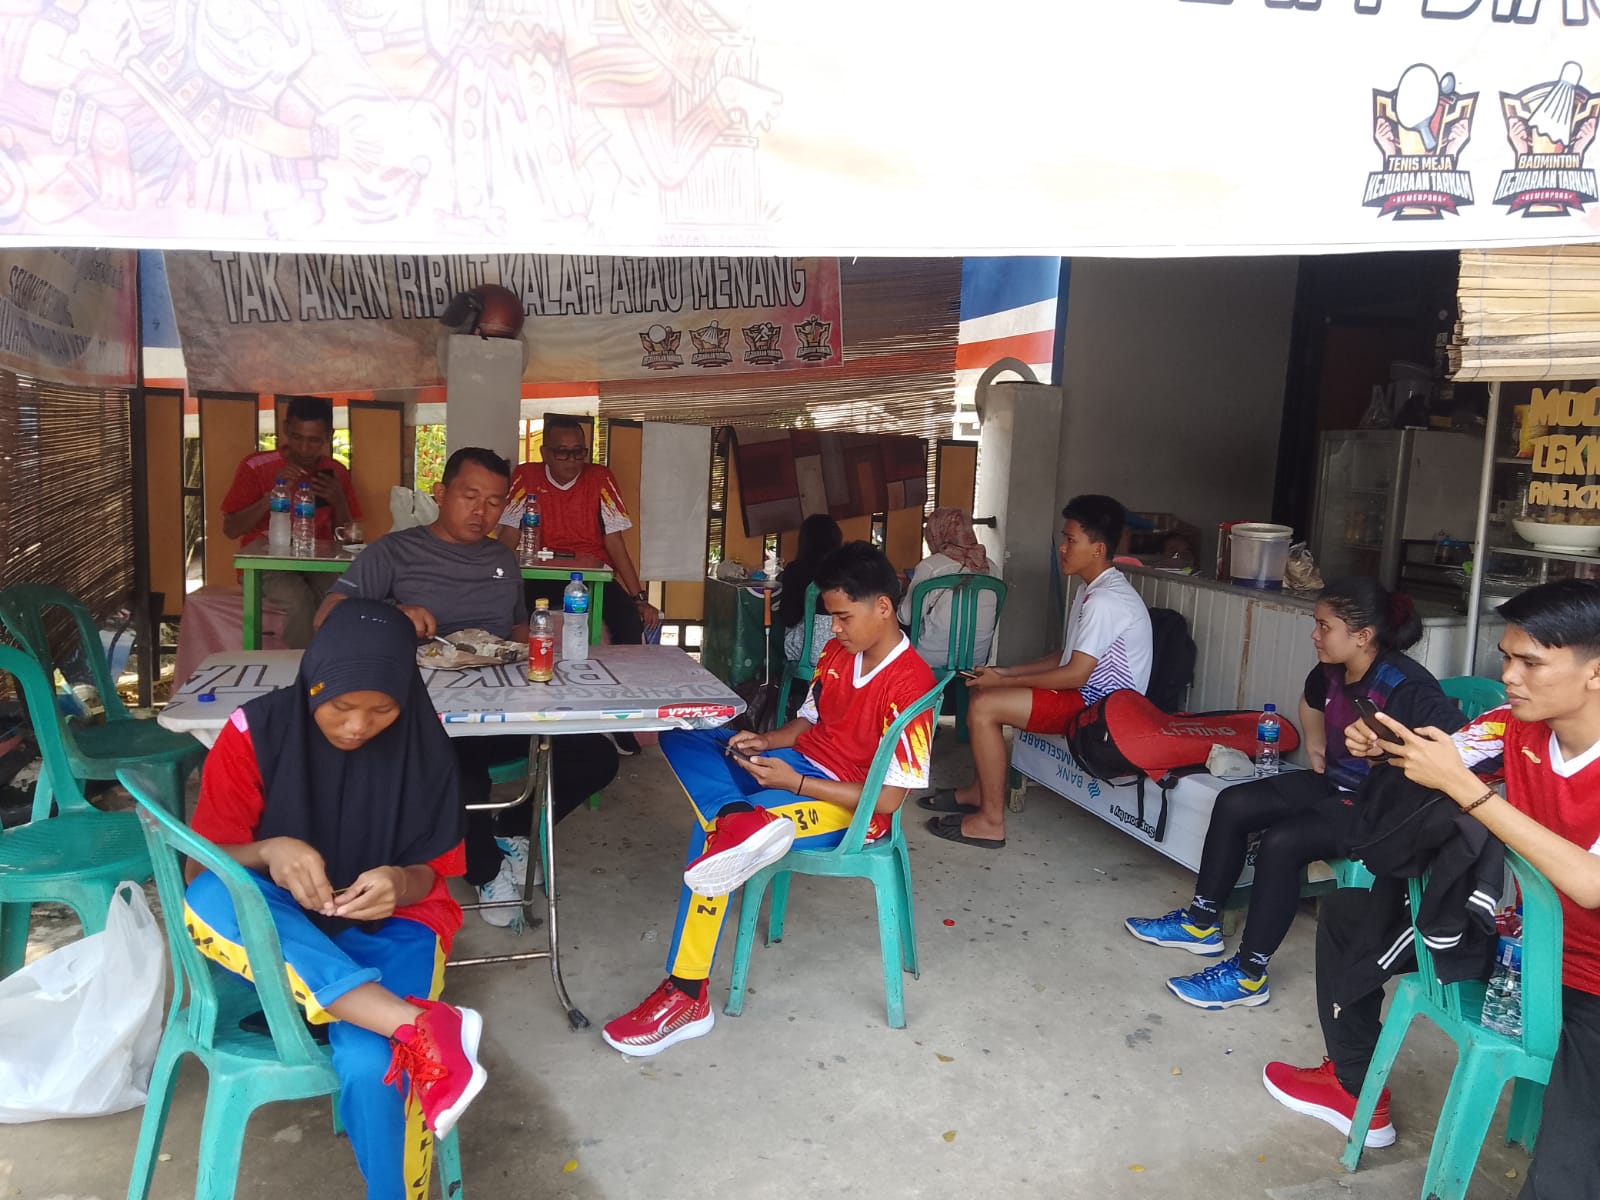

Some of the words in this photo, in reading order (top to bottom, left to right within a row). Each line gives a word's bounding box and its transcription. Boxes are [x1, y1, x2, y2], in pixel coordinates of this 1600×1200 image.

[1388, 156, 1419, 171] TENIS
[1421, 156, 1453, 171] MEJA
[1518, 154, 1580, 169] BADMINTON
[1364, 172, 1430, 203] KEJUARAAN
[1430, 171, 1473, 202] TARKAM
[1494, 169, 1557, 201] KEJUARAAN
[1557, 168, 1597, 199] TARKAM
[210, 250, 292, 324] TAK
[296, 252, 392, 321] AKAN
[395, 253, 489, 319] RIBUT
[496, 253, 603, 317] KALAH
[609, 255, 684, 315] ATAU
[690, 255, 806, 311] MENANG
[1056, 764, 1084, 789] BANK
[1113, 805, 1124, 821] by
